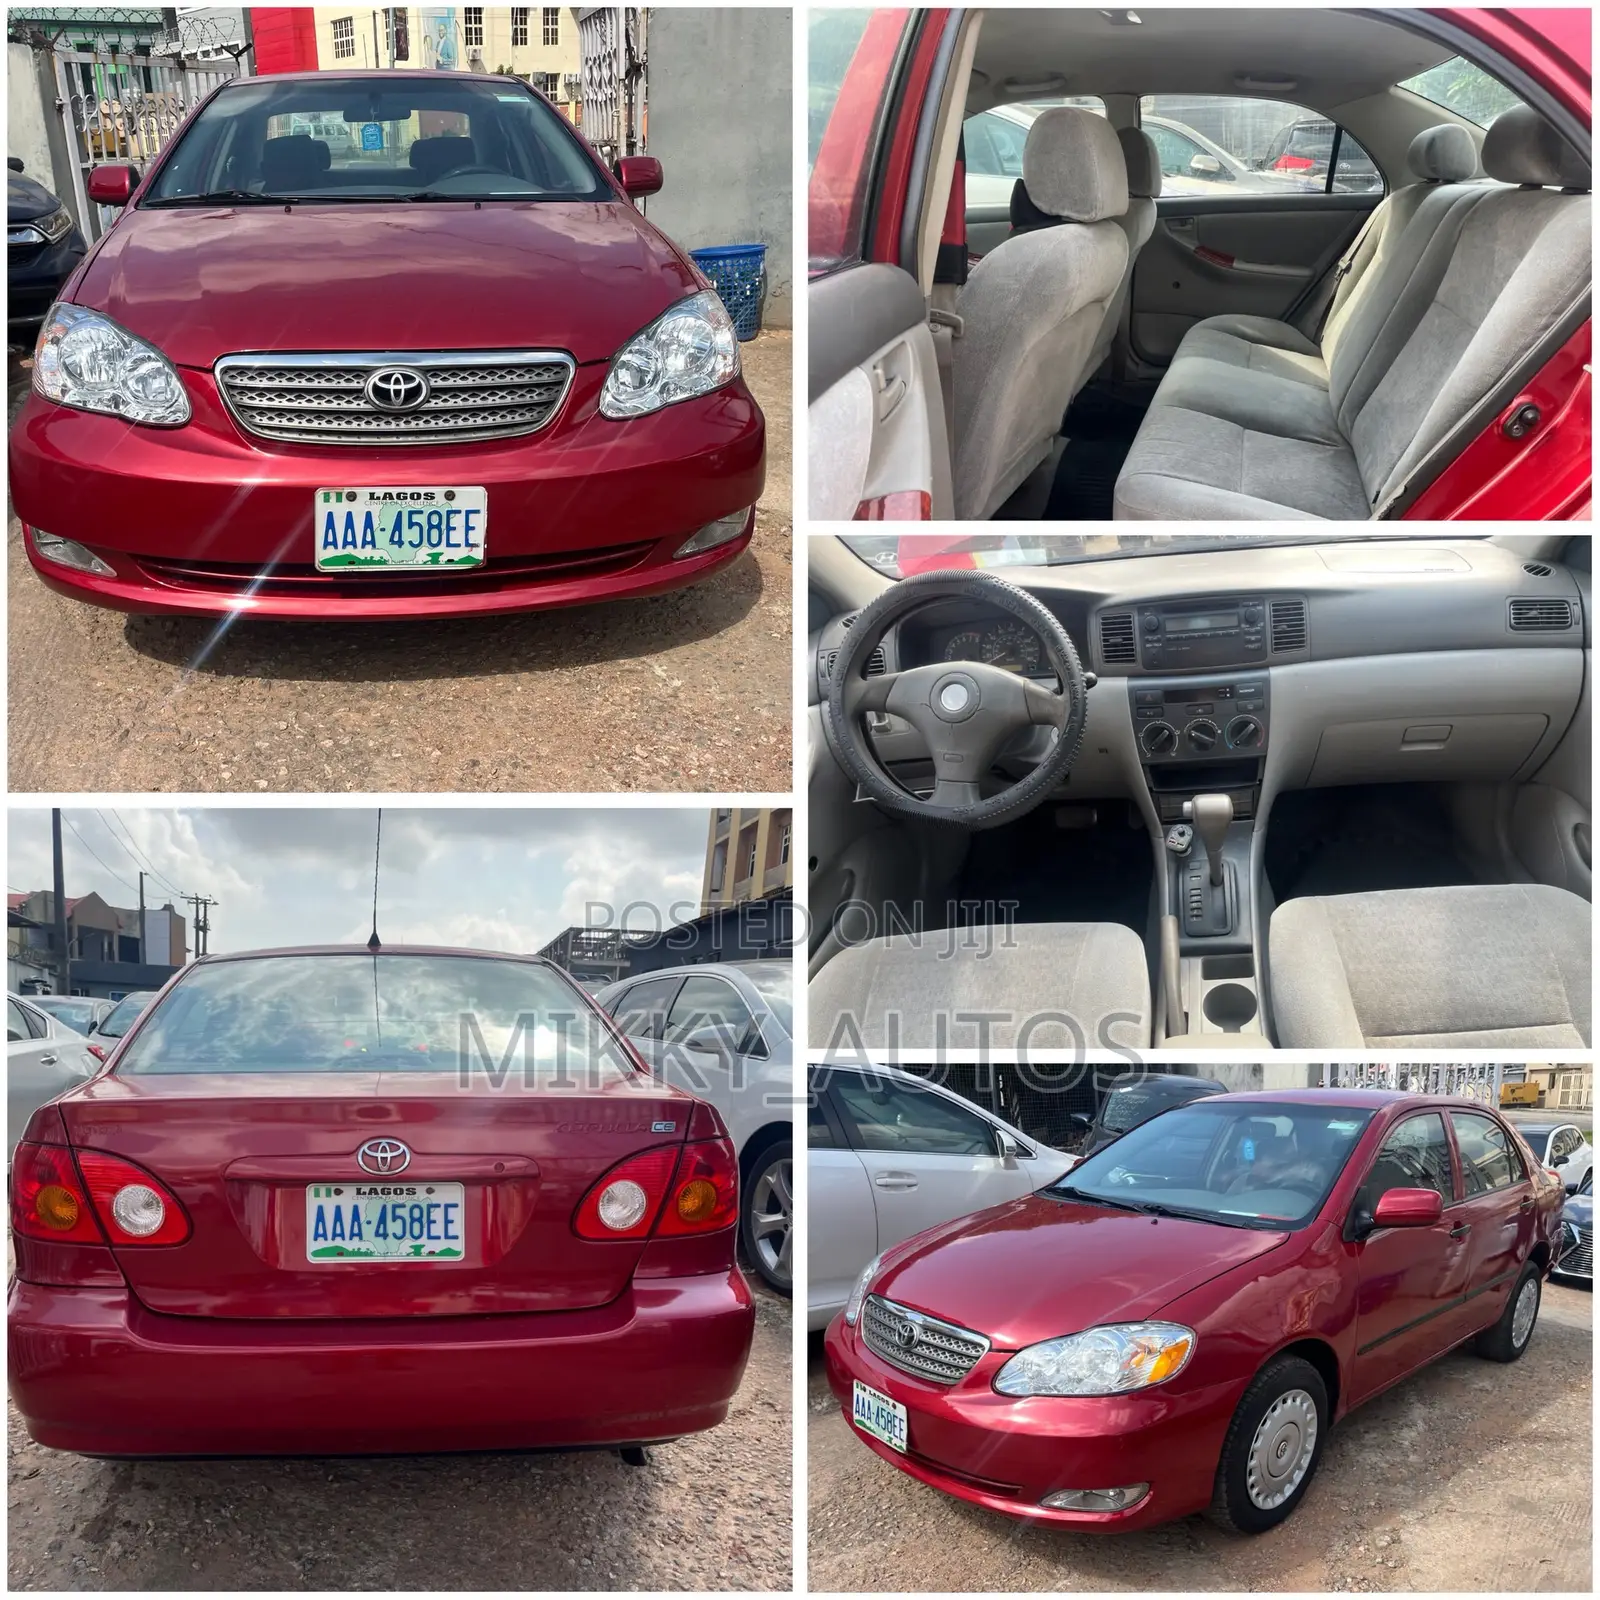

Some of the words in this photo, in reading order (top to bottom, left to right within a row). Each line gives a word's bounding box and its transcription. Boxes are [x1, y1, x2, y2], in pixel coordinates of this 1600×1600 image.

[368, 492, 436, 501] LAGOS
[322, 510, 481, 550] AAA-458EE
[652, 1122, 675, 1132] CE
[355, 1187, 417, 1196] LAGOS
[313, 1203, 459, 1241] AAA-458EE
[855, 1393, 905, 1443] AAA-458EE
